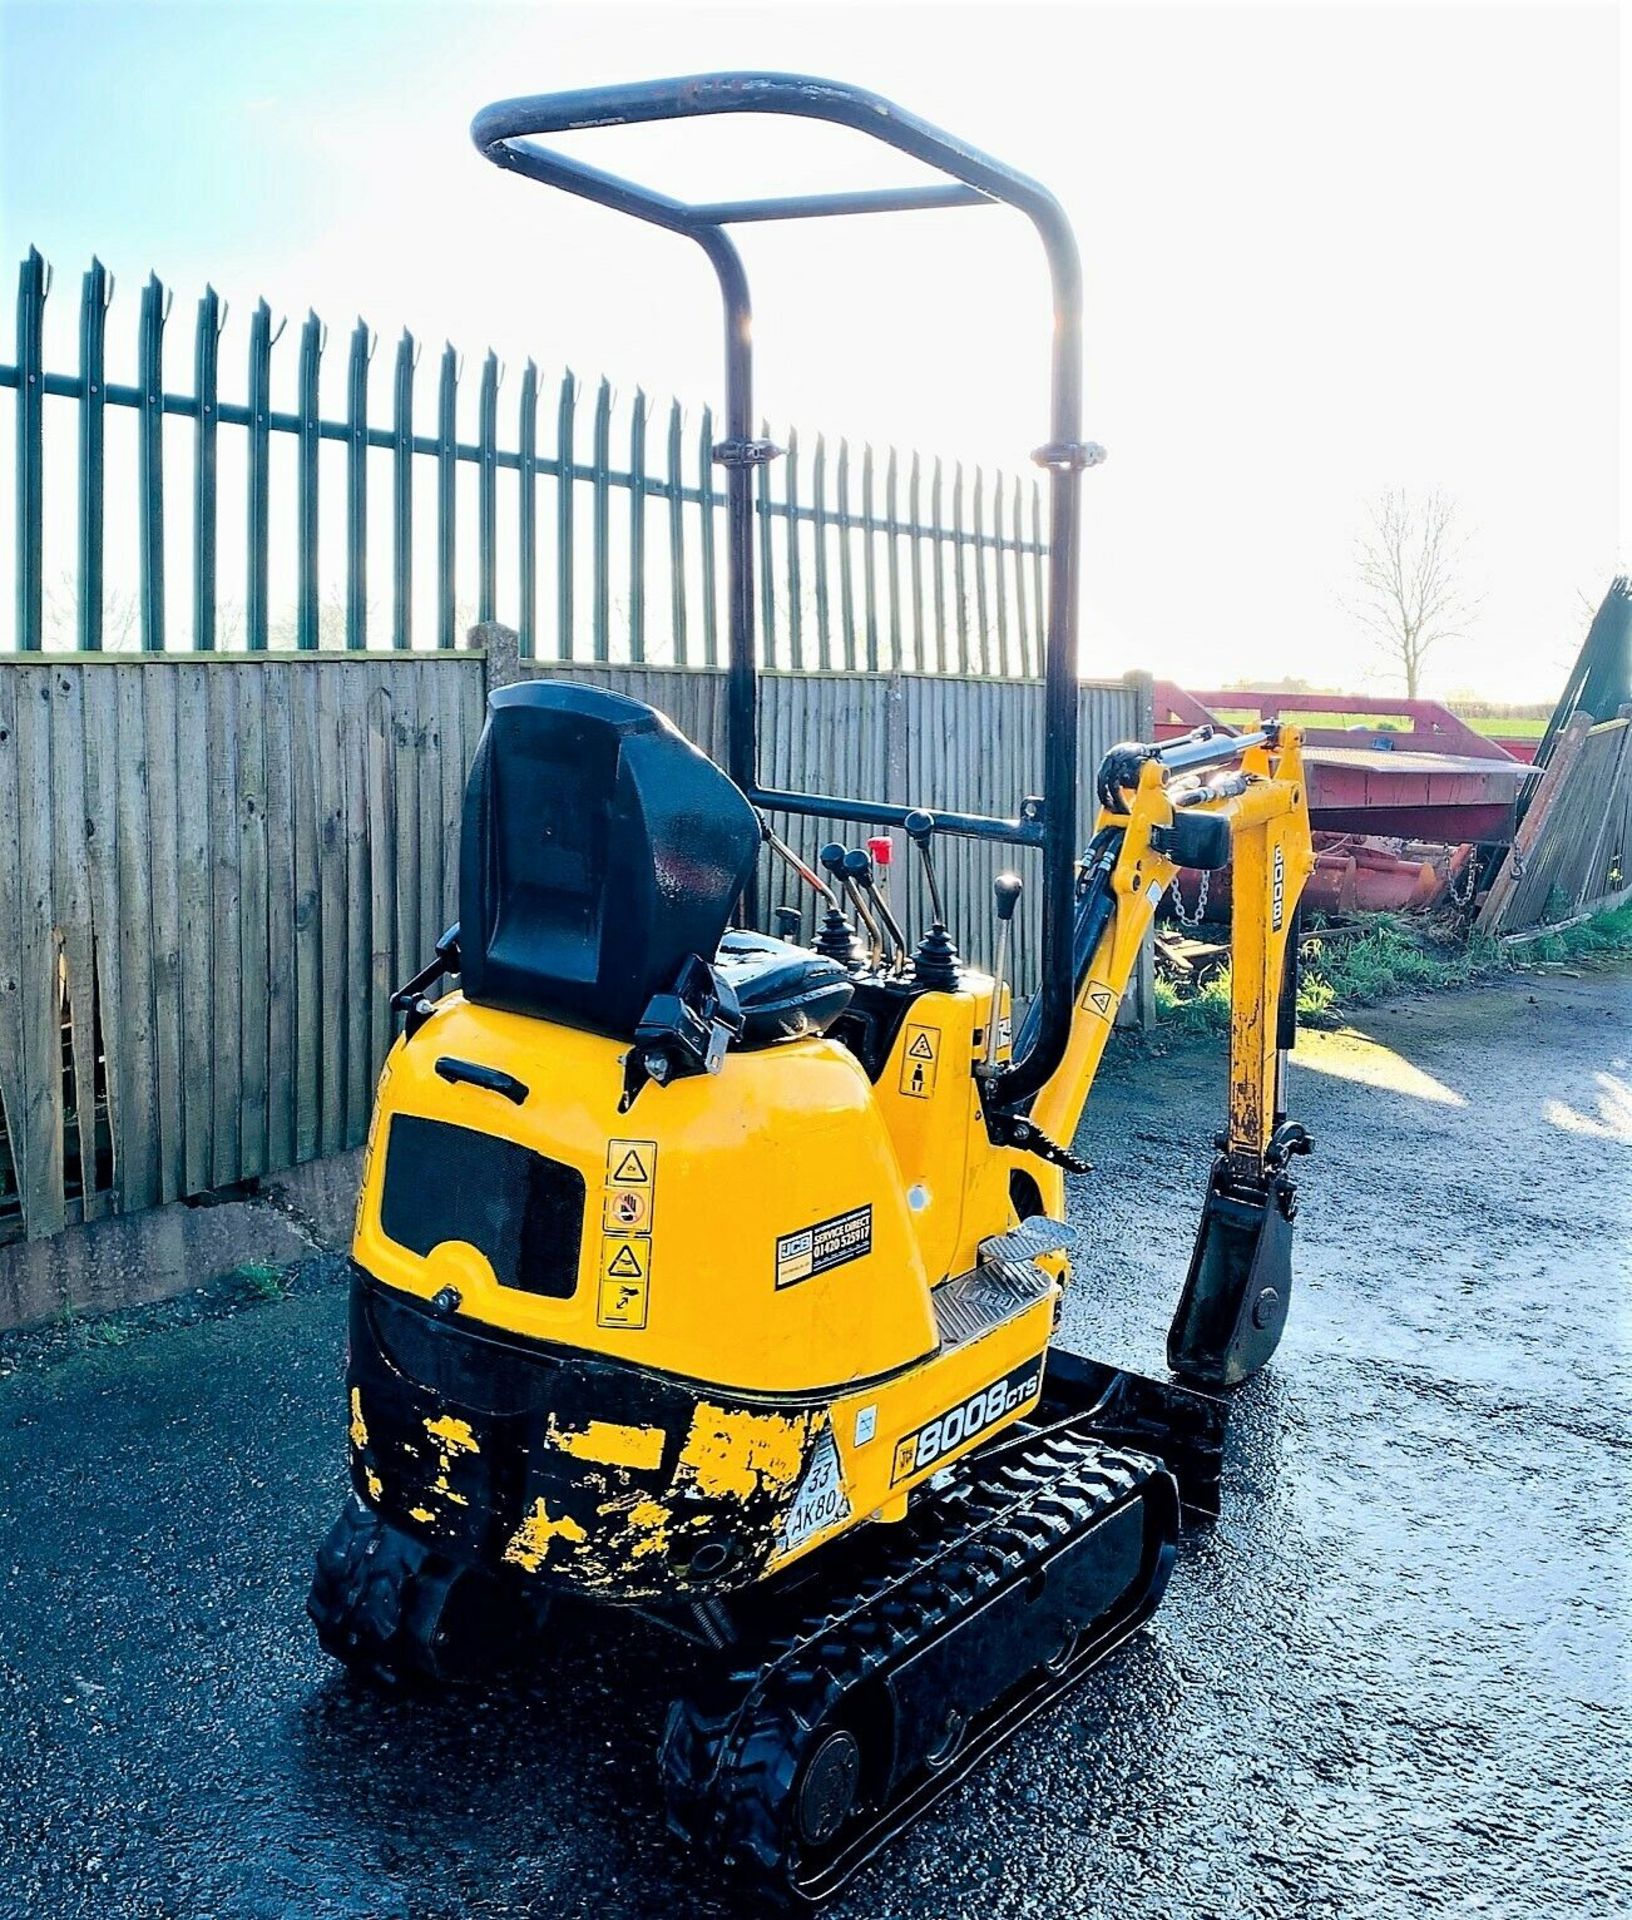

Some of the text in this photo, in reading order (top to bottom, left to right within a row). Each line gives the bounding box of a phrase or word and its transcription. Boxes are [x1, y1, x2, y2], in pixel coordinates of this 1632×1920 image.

[813, 1225, 845, 1245] SERVICE
[845, 1216, 870, 1233] DIRECT
[781, 1236, 810, 1257] JCB
[808, 1461, 834, 1494] 33
